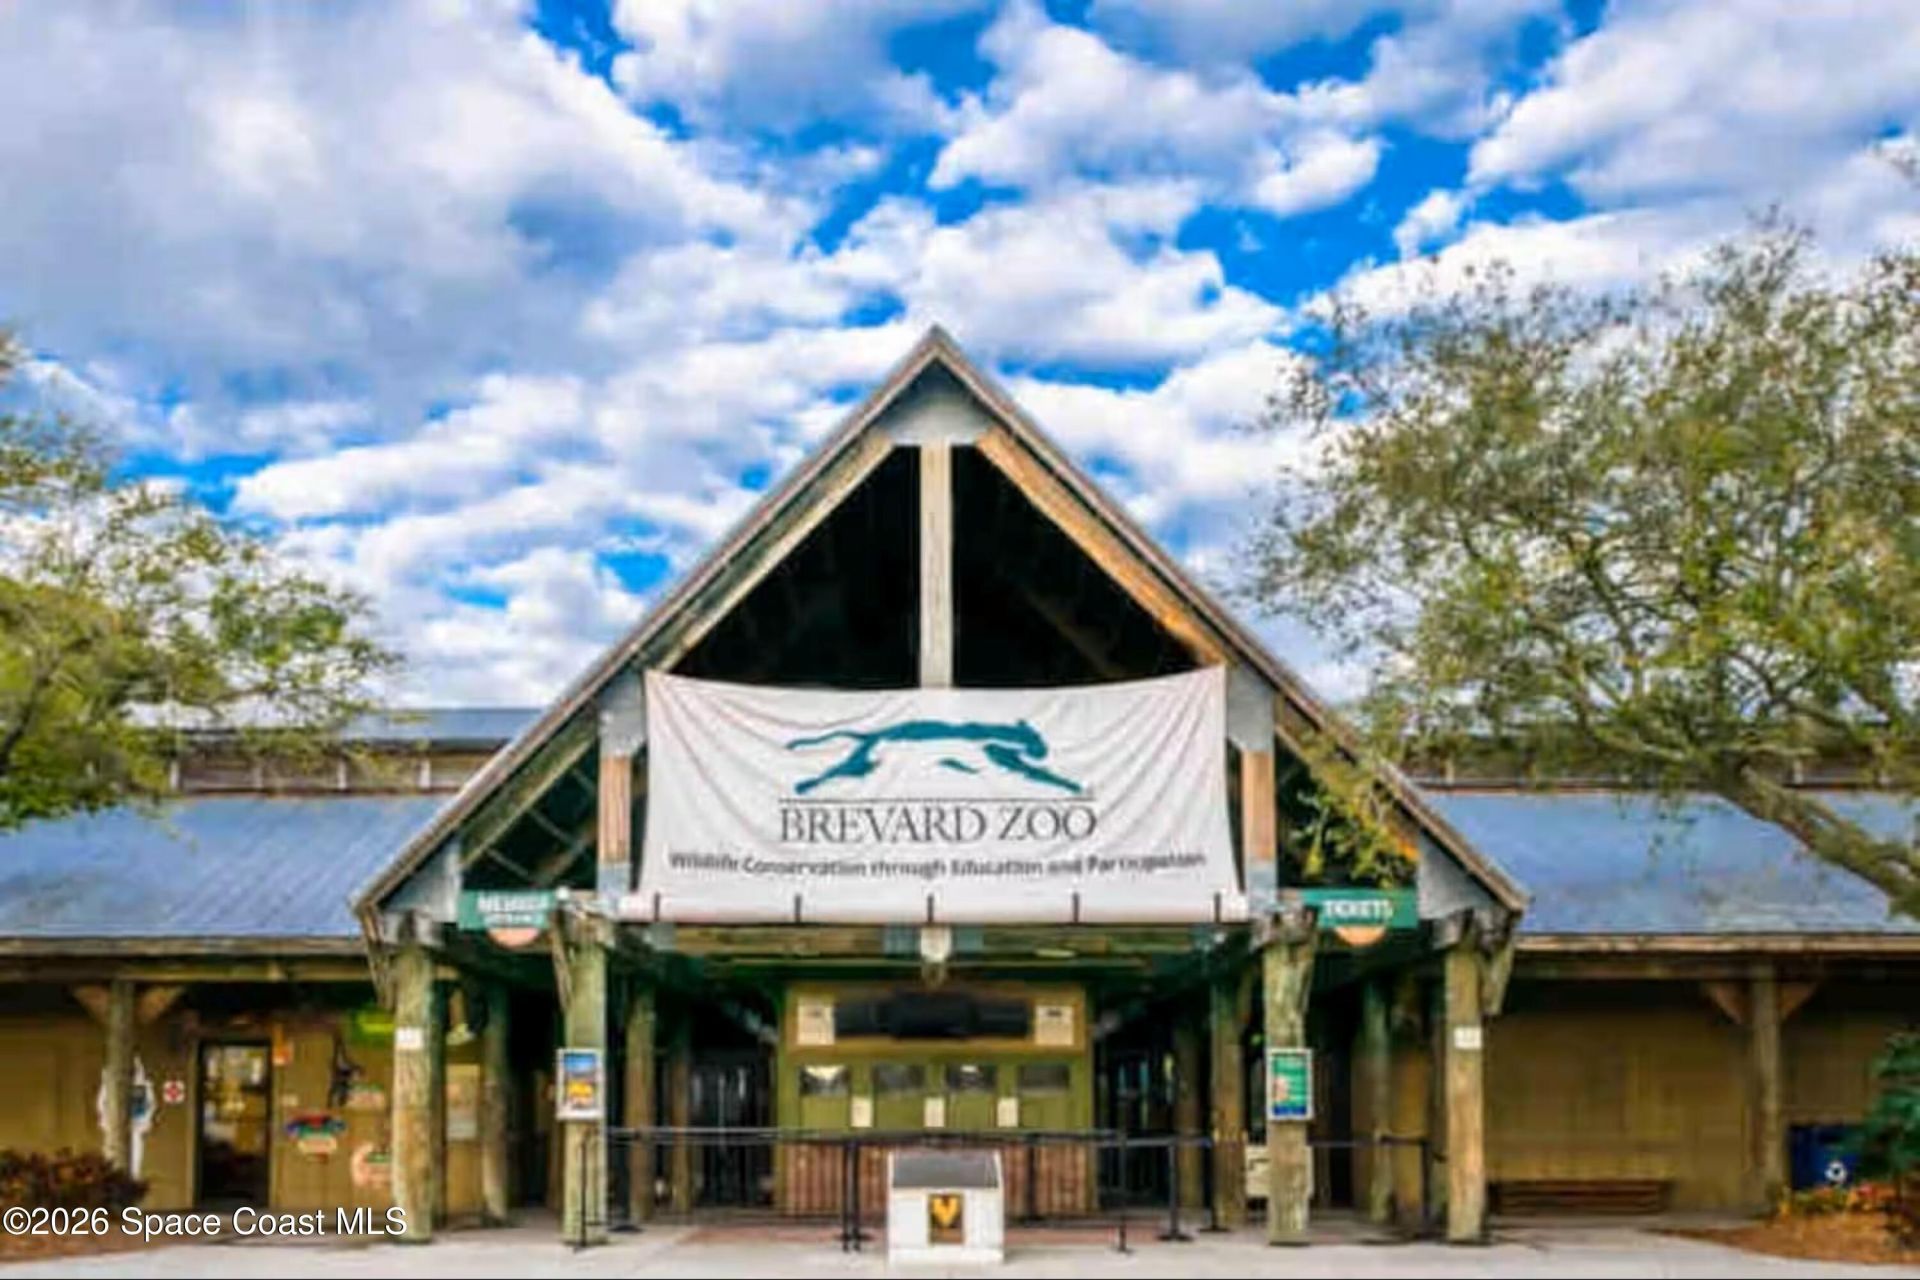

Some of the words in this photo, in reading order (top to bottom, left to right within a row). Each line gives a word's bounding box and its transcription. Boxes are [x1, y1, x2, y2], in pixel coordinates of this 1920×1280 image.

[780, 807, 987, 842] BREVARD
[999, 805, 1097, 841] ZOO
[742, 856, 866, 876] Conservation
[871, 857, 947, 880] through
[952, 858, 1043, 876] Education
[1049, 859, 1083, 876] and
